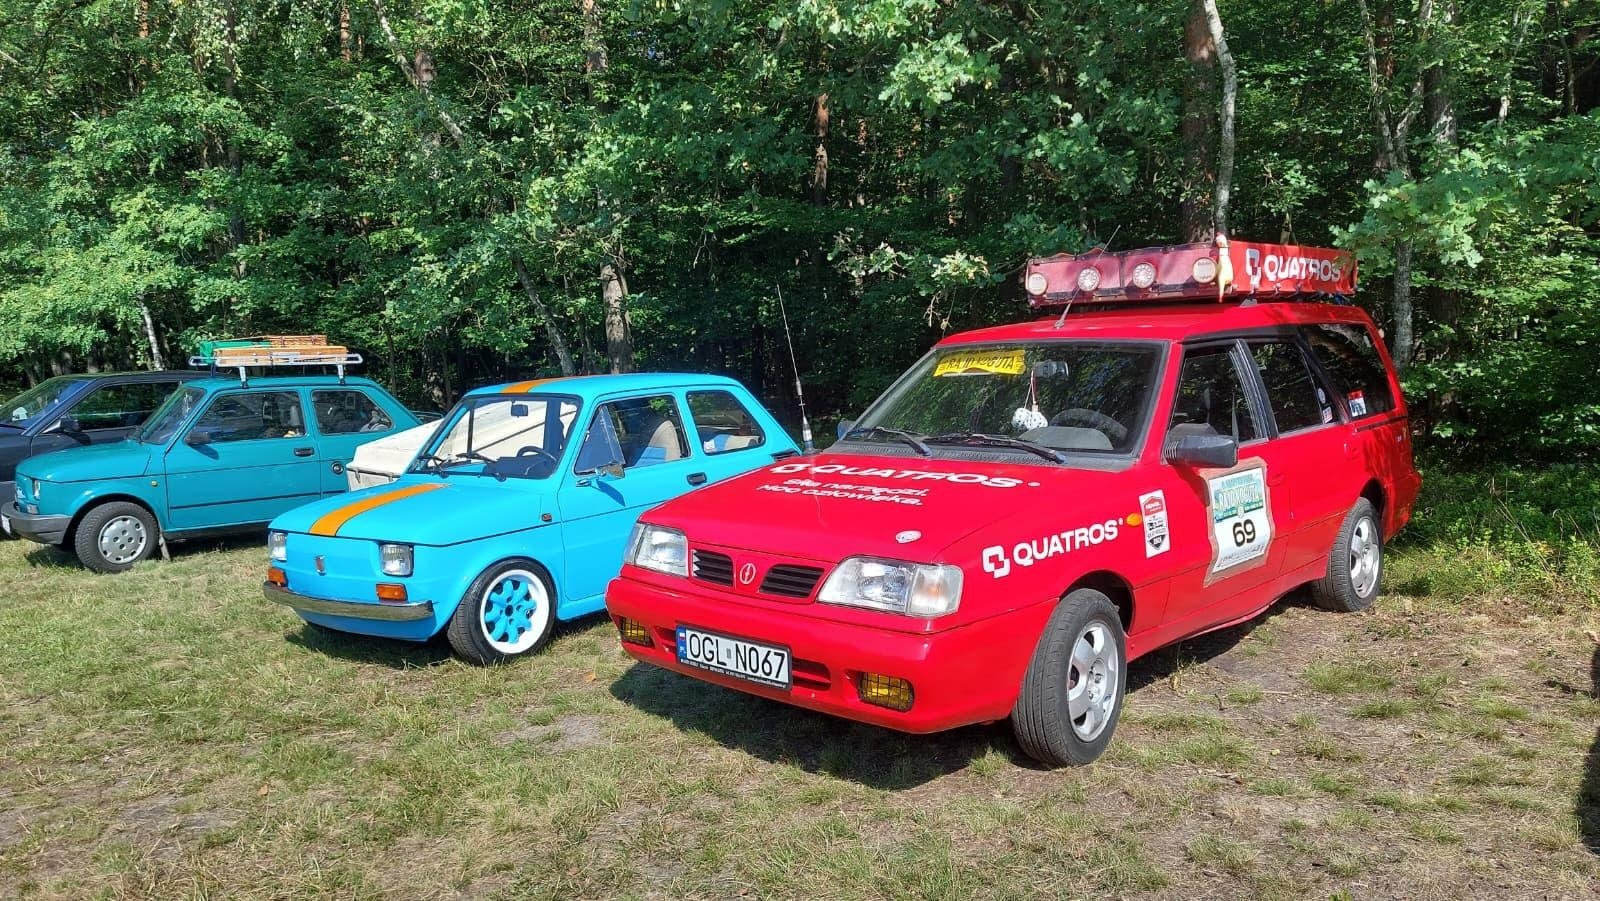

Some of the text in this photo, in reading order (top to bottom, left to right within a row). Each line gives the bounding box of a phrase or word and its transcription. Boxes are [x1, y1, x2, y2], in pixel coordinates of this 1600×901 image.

[1264, 254, 1341, 282] QUATROS
[812, 463, 1024, 488] QUATROS
[1013, 519, 1119, 567] QUATROS
[1232, 518, 1256, 547] 69
[689, 633, 727, 666] OGL
[735, 643, 786, 680] N067
